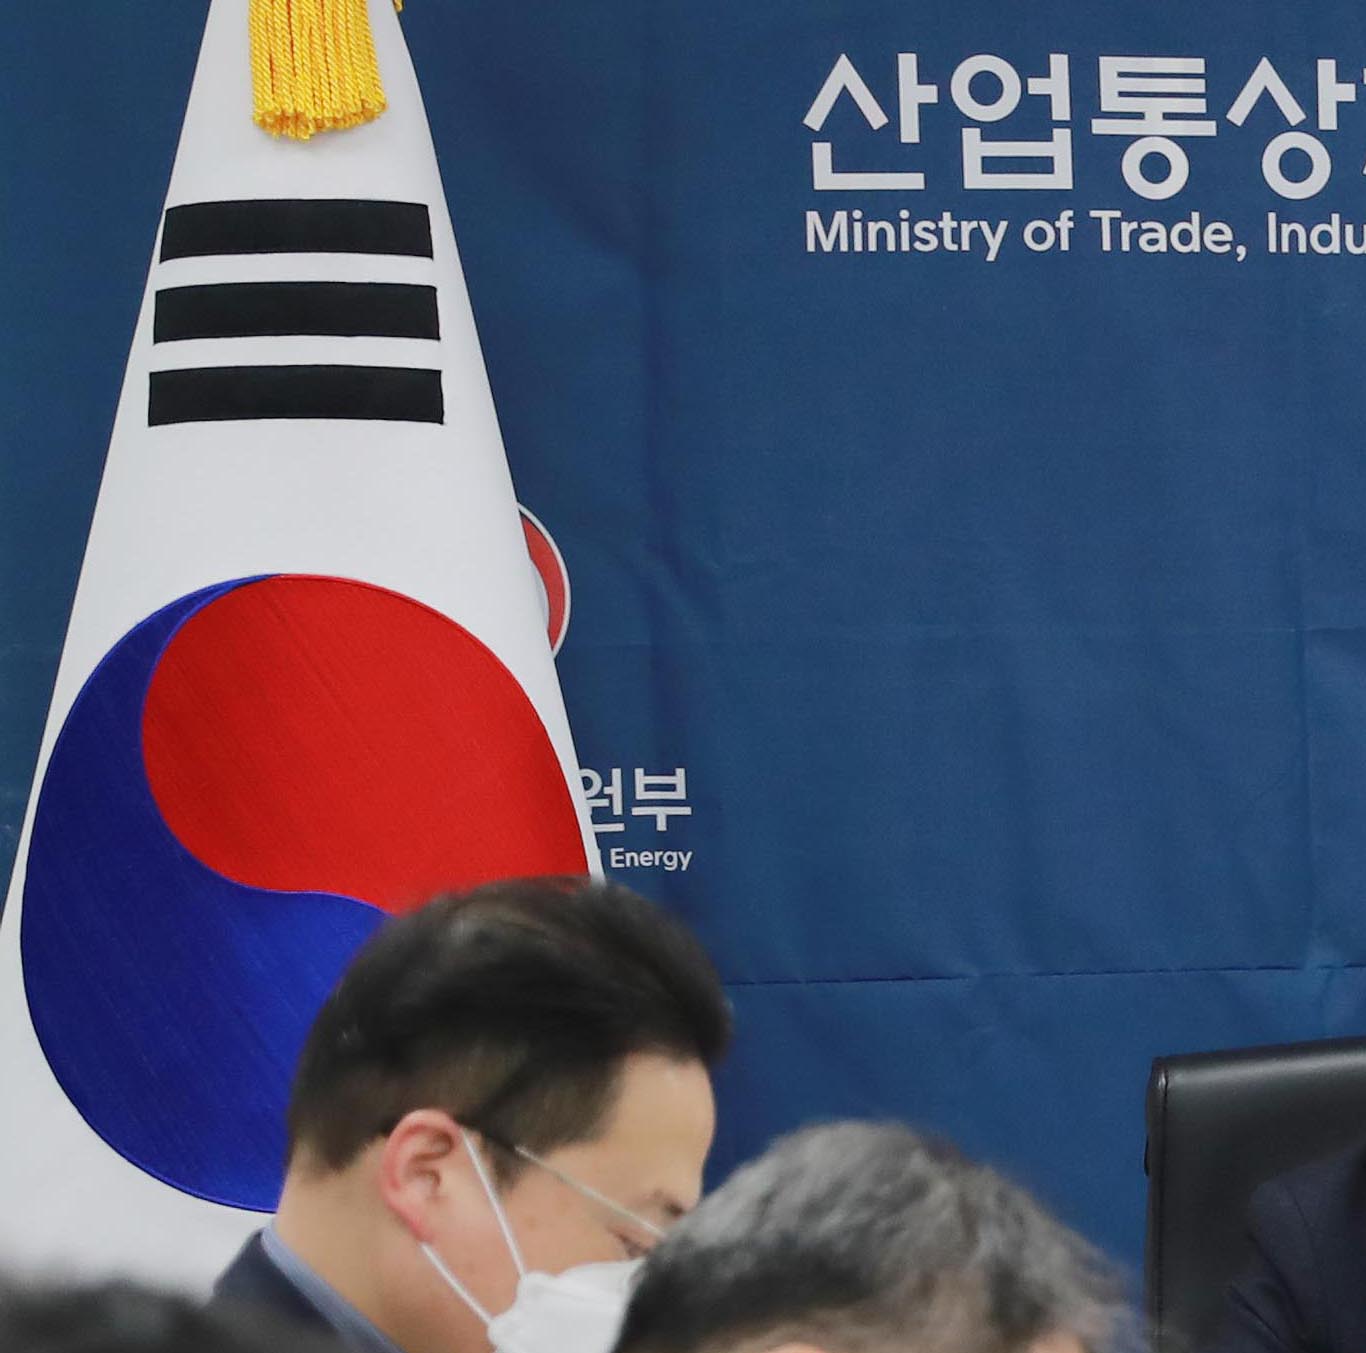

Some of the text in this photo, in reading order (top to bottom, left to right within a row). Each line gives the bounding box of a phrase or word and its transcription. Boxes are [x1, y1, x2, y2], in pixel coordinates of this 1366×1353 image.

[805, 209, 1009, 262] Ministry
[1023, 209, 1075, 252] of
[1089, 209, 1247, 262] Trade,
[609, 847, 693, 872] Energy
